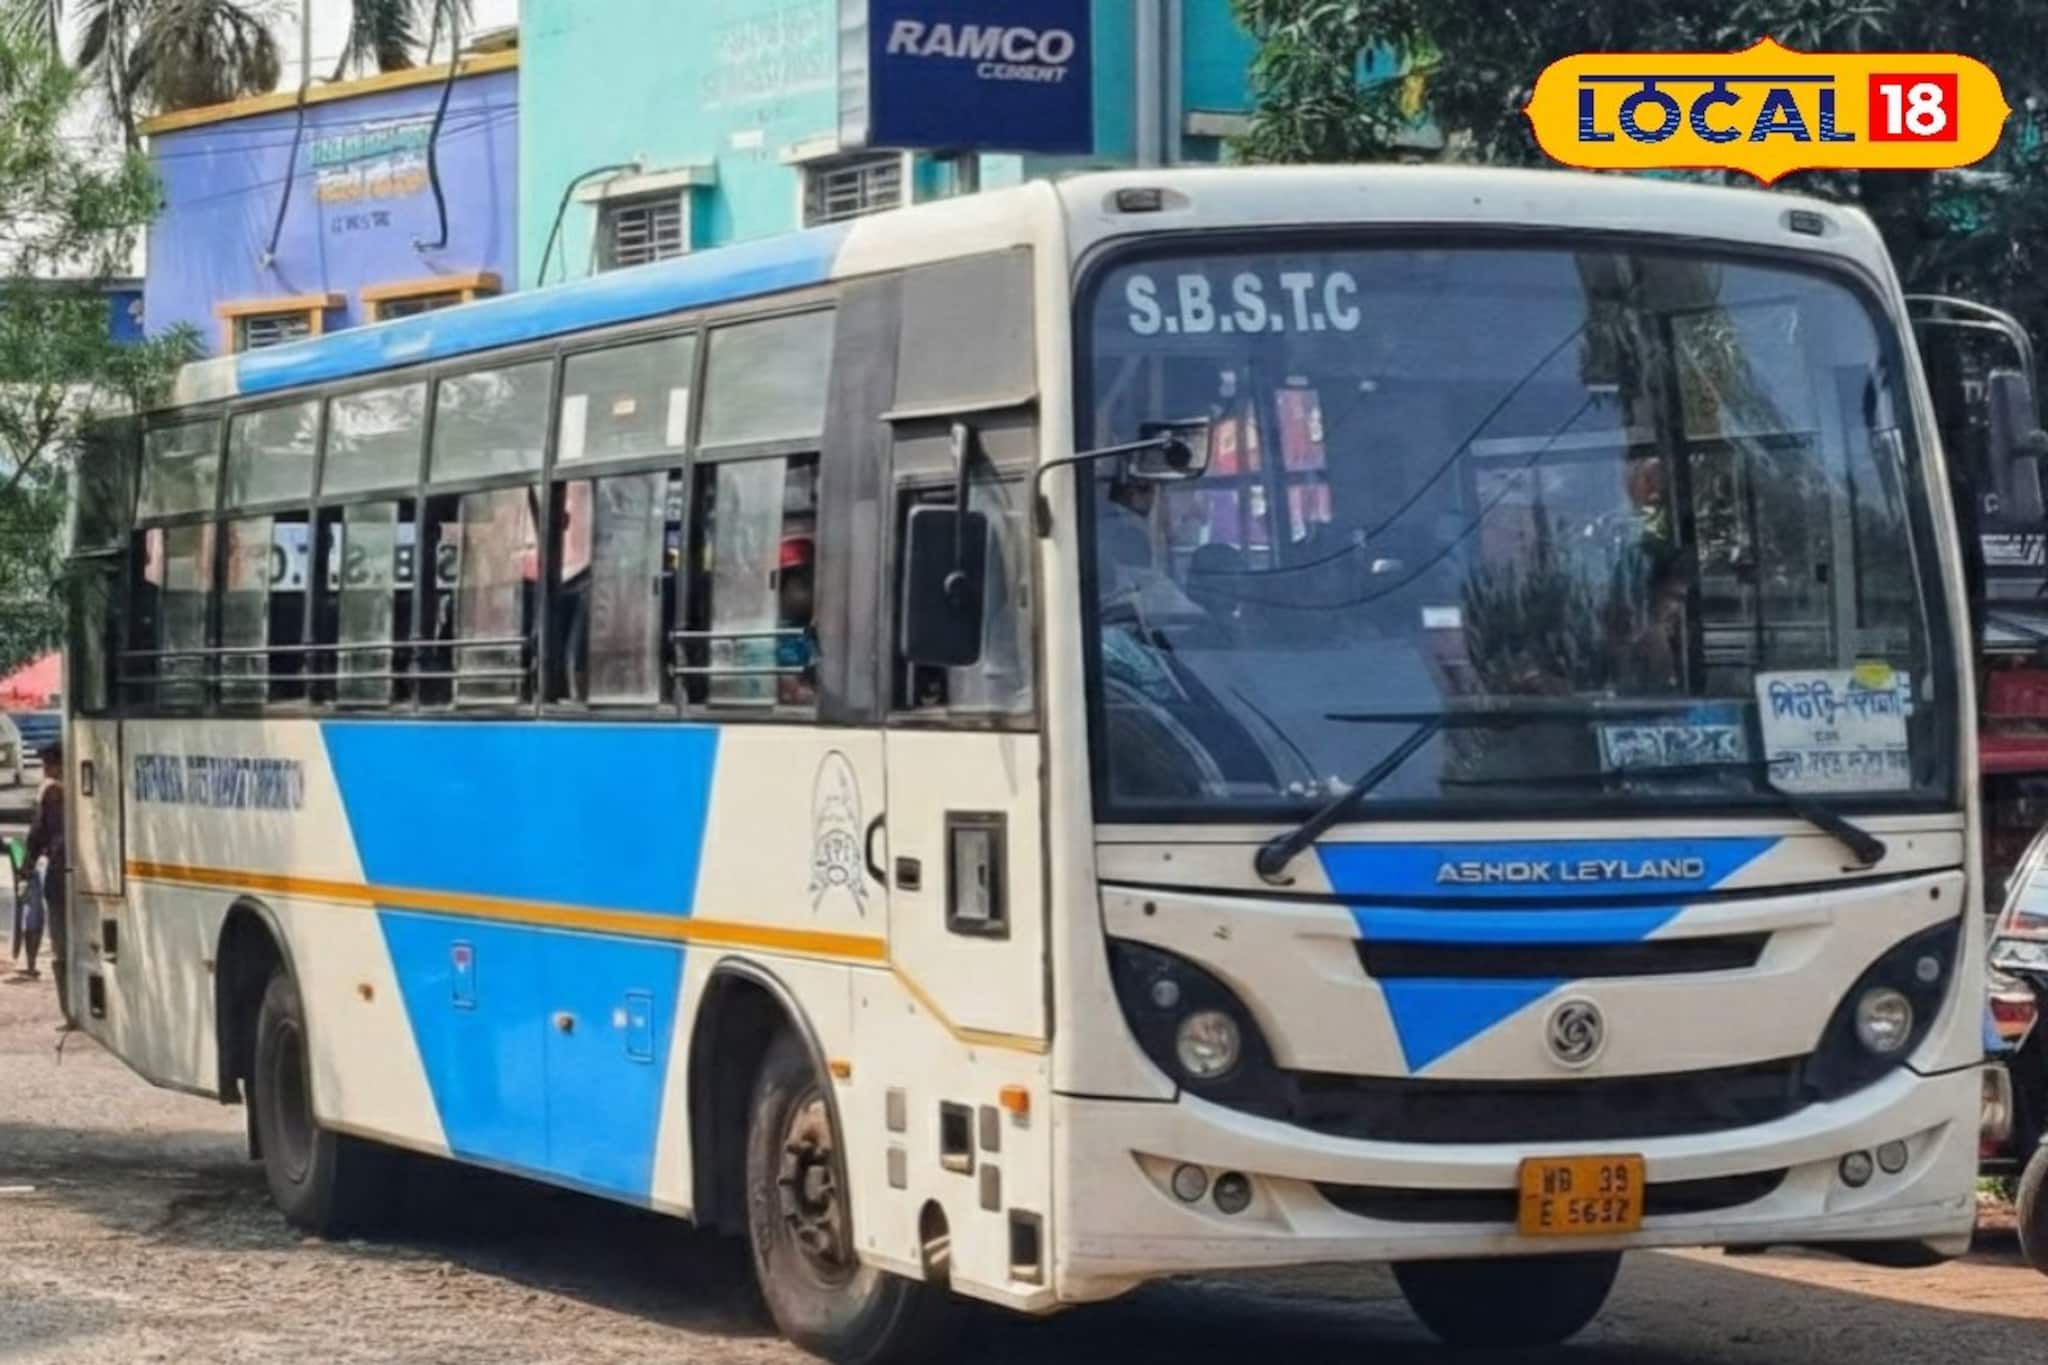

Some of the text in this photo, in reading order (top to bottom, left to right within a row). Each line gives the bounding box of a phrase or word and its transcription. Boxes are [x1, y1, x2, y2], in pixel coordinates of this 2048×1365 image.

[887, 19, 1075, 65] RAMCO
[976, 62, 1068, 83] CEMENT
[1125, 271, 1361, 335] S.B.S.T.C
[1436, 857, 1705, 884] ASHOK LEYLAND
[1542, 1164, 1628, 1194] WB 39
[1540, 1199, 1554, 1227] E
